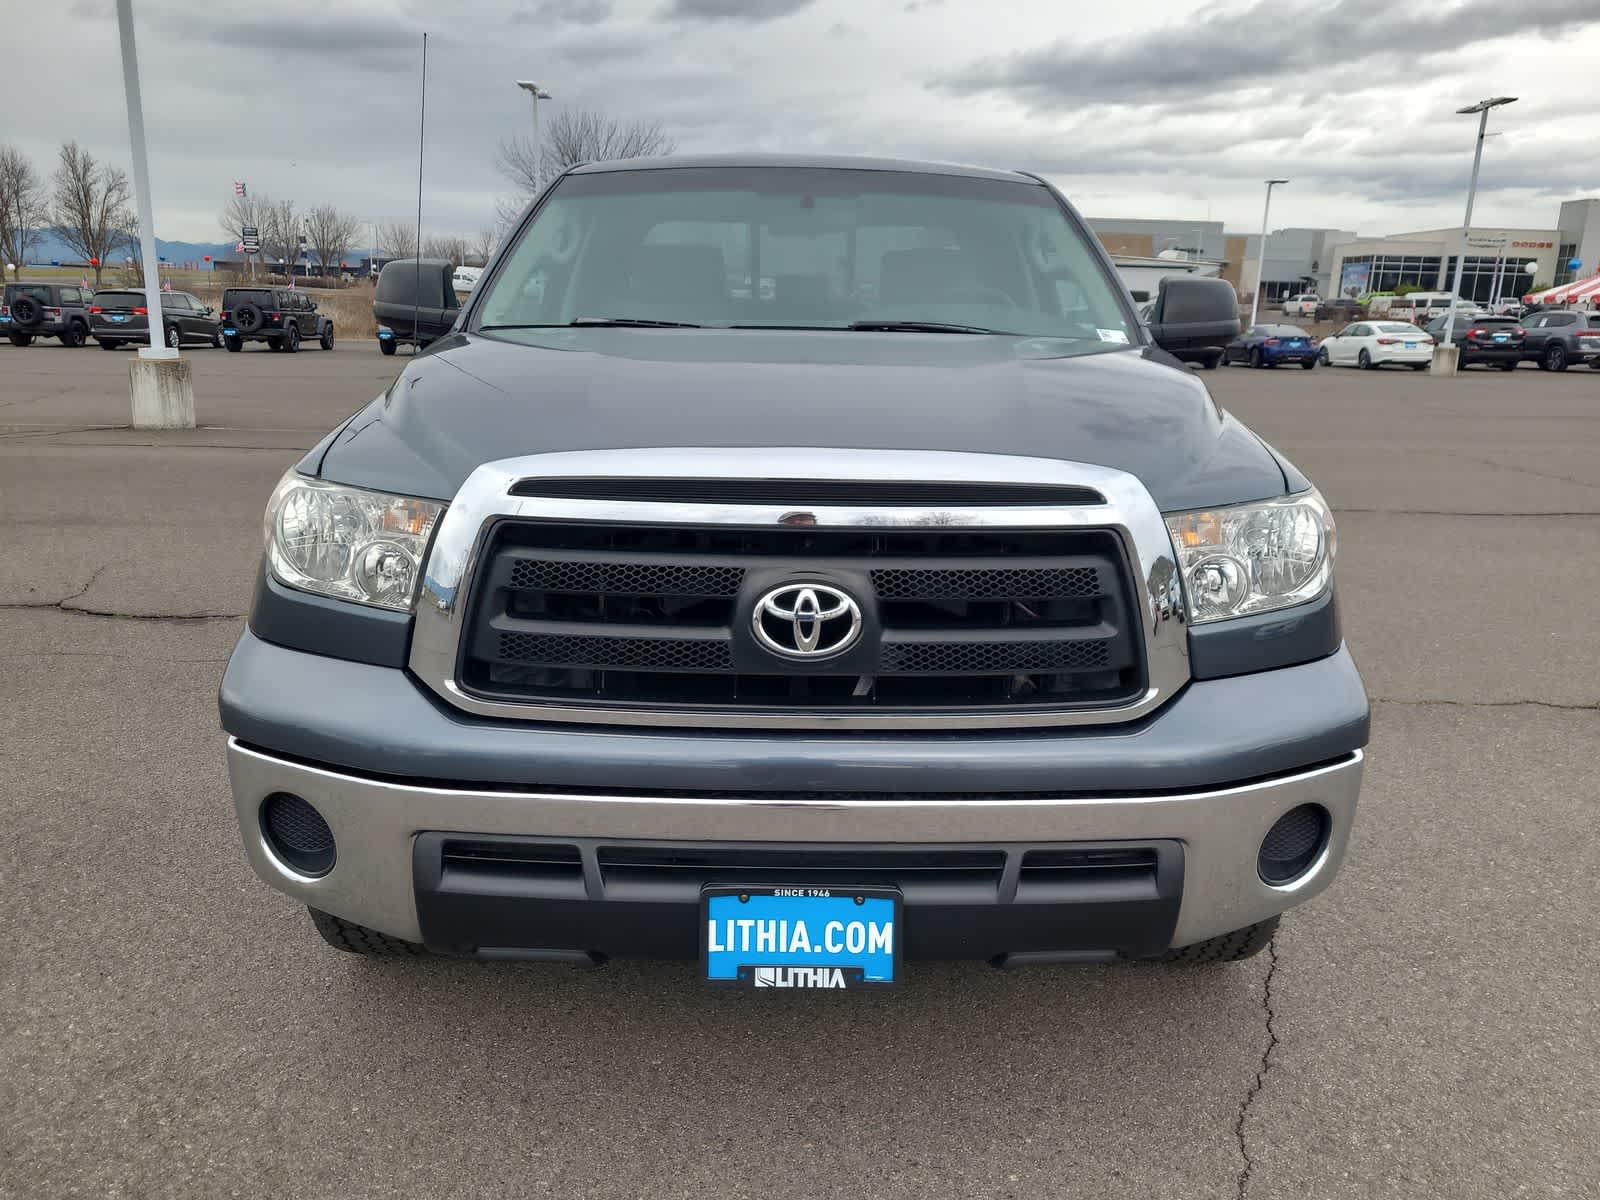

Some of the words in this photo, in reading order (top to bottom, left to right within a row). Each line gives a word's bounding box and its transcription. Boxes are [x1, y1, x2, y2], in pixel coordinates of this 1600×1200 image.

[774, 889, 804, 897] SINCE
[807, 889, 830, 898] 1946
[708, 919, 893, 954] LITHIA.COM
[775, 967, 847, 989] LITHIA
